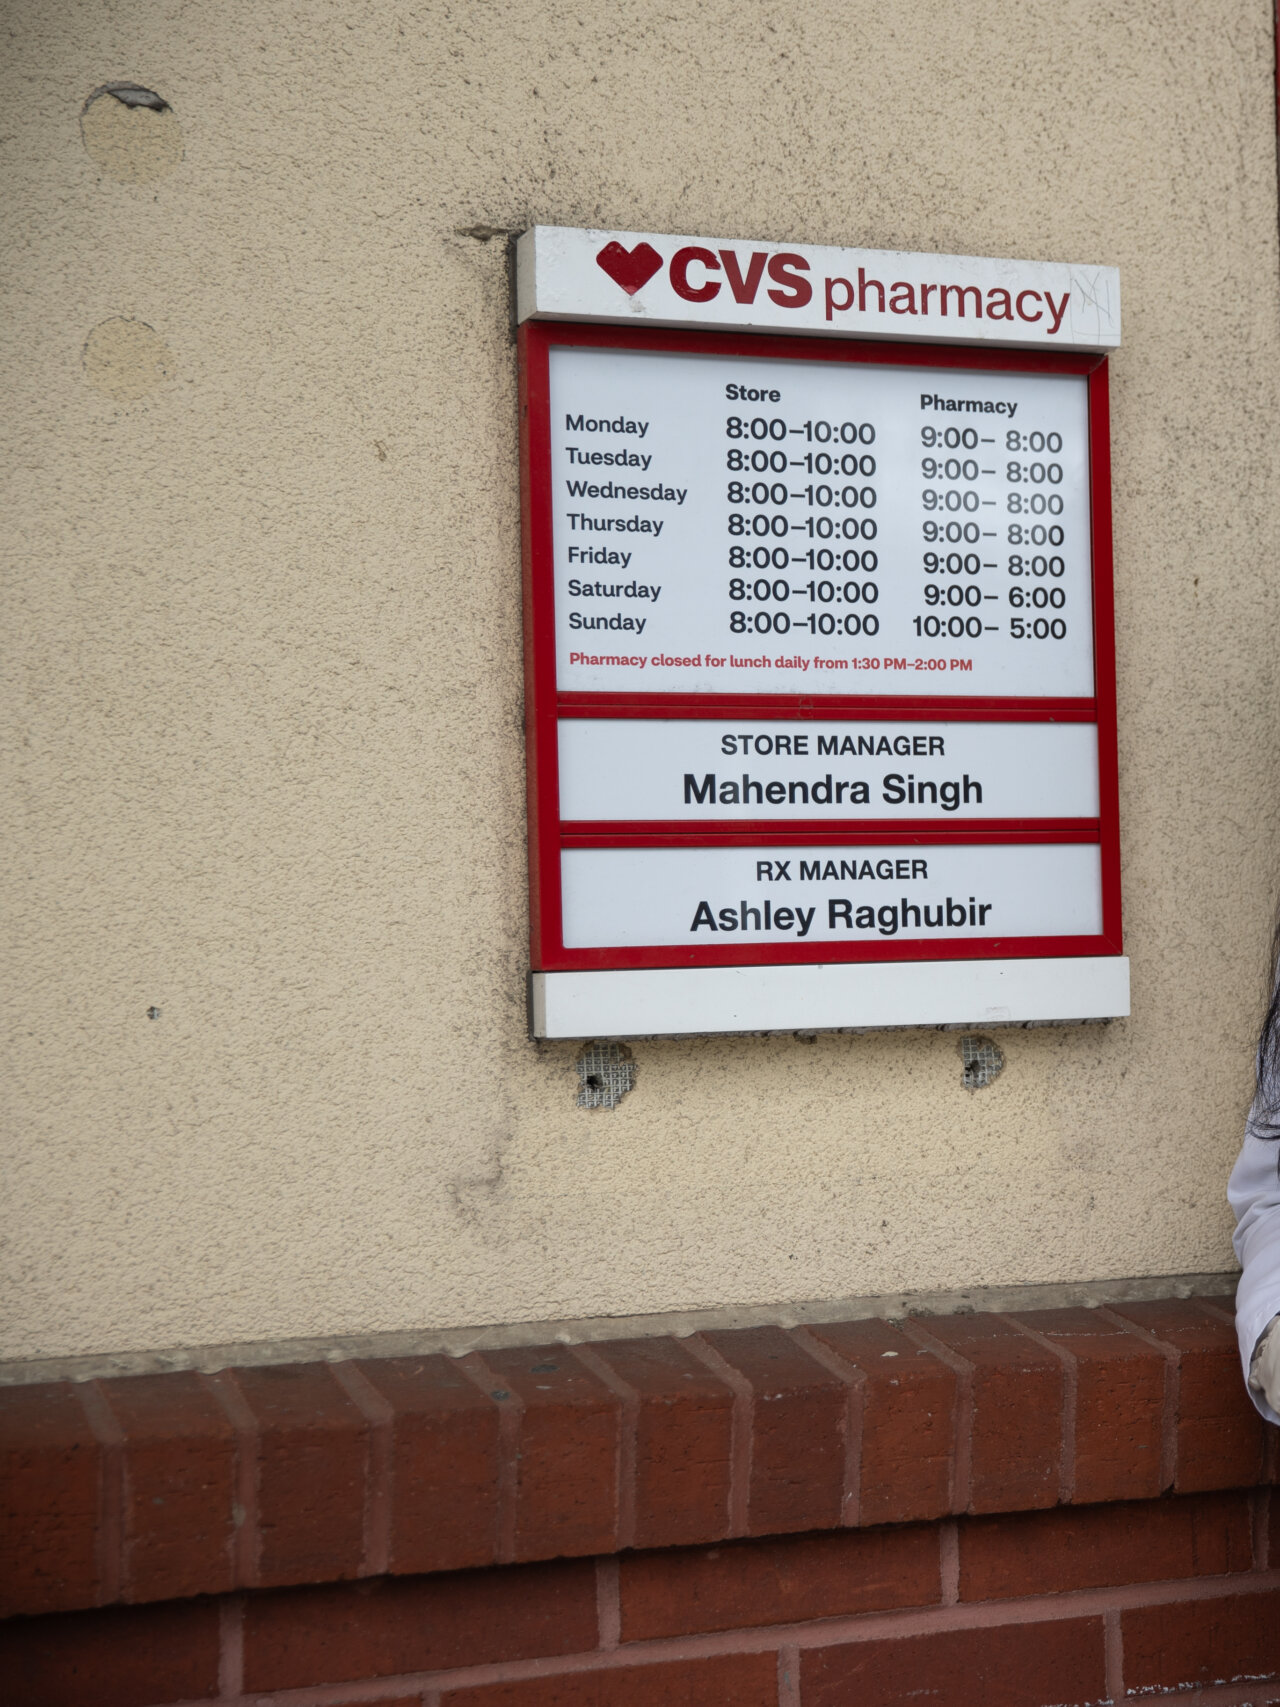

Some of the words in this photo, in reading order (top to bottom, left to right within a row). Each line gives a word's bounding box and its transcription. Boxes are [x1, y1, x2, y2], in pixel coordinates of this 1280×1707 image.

[670, 247, 812, 308] CVS
[825, 268, 1070, 334] pharmacy
[726, 384, 780, 402] Store
[921, 394, 1017, 418] Pharmacy
[566, 414, 649, 438] Monday
[566, 447, 652, 471] Tuesday
[566, 480, 687, 505] Wednesday
[567, 513, 663, 537] Thursday
[569, 547, 632, 568] Friday
[569, 580, 661, 602] Saturday
[569, 612, 646, 634] Sunday
[570, 652, 647, 668] Pharmacy
[651, 654, 701, 667] closed
[705, 655, 726, 667] for
[730, 655, 771, 667] lunch
[775, 656, 810, 671] daily
[814, 656, 848, 669] from
[852, 658, 880, 669] 1:30
[950, 659, 973, 671] PM
[721, 735, 808, 755] STORE
[818, 736, 944, 756] MANAGER
[684, 774, 870, 804] Mahendra
[883, 774, 982, 811] Singh
[757, 861, 791, 881] RX
[800, 860, 928, 880] MANAGER
[690, 900, 816, 936] Ashley
[829, 897, 992, 935] Raghubir
